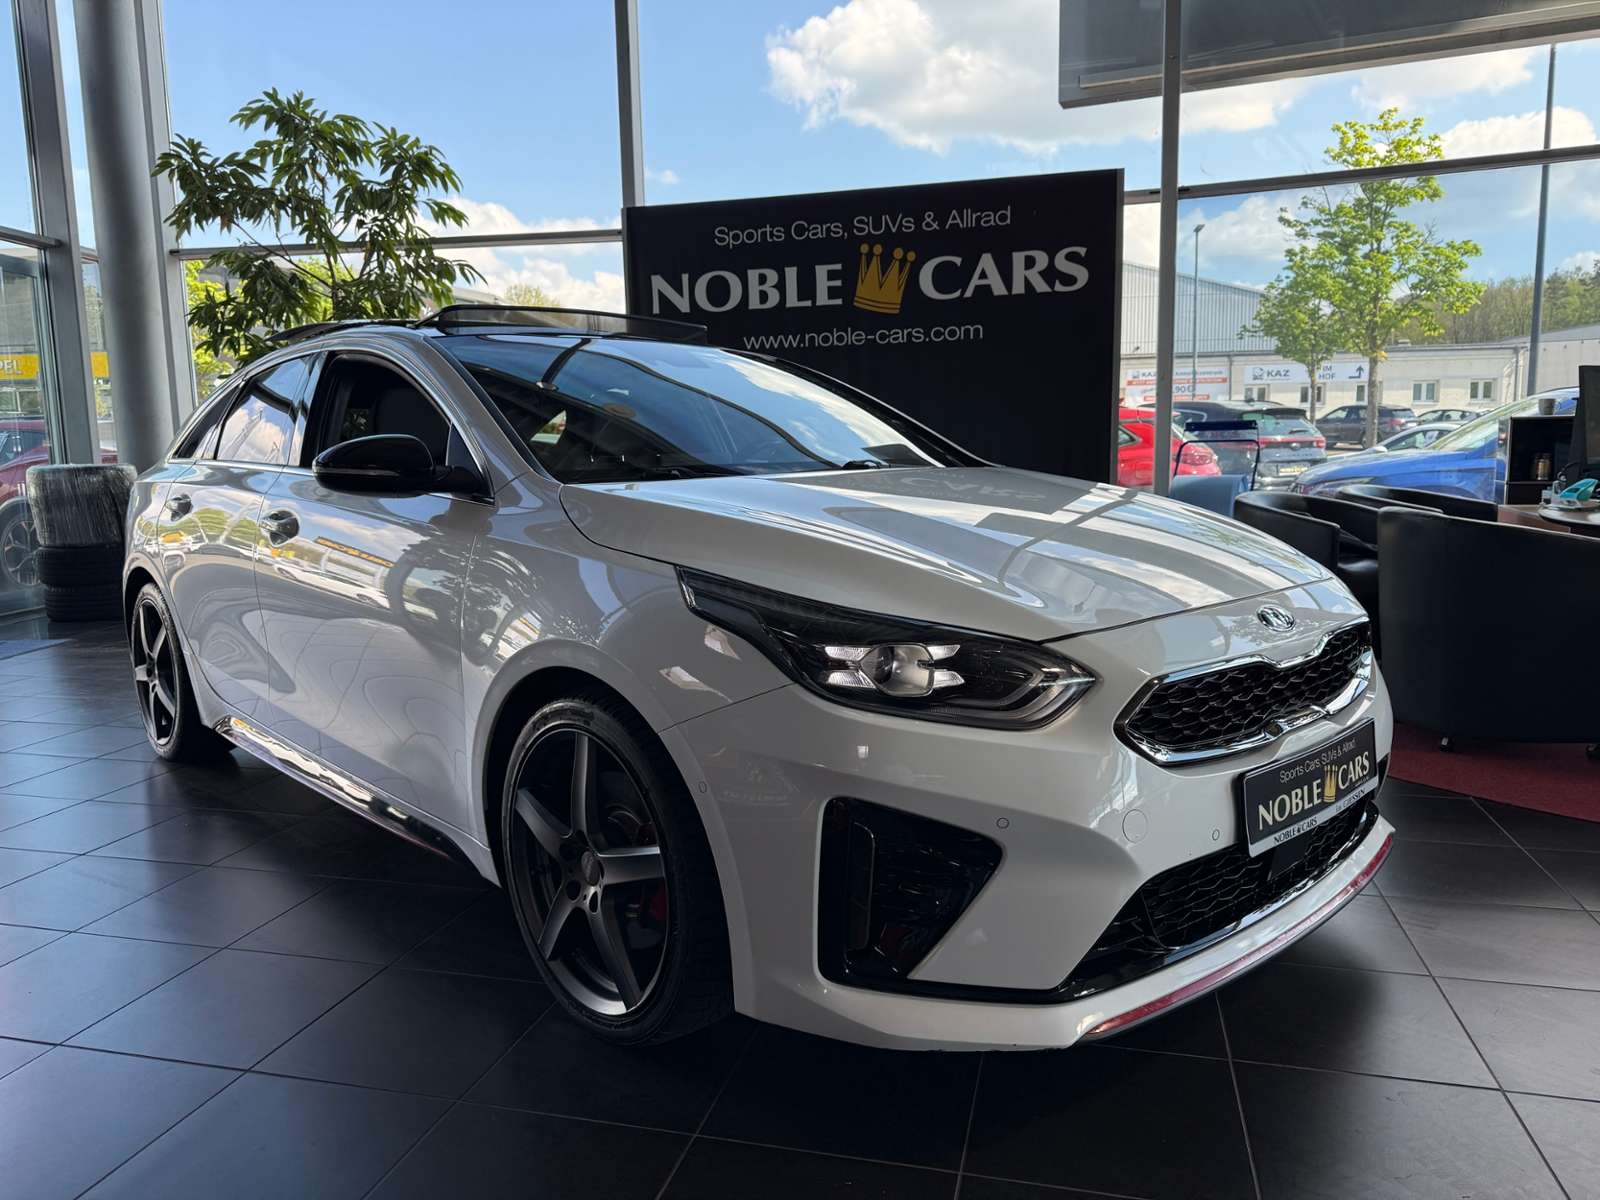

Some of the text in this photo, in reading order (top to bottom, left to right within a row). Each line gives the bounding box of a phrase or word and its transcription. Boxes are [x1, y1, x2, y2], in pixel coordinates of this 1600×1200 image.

[714, 206, 1011, 249] Sports Cars, SUVs & Allrad
[650, 246, 1089, 315] NOBLE CARS
[743, 322, 984, 351] www.noble-cars.com
[1266, 368, 1291, 378] KAZ
[1280, 766, 1304, 783] Sports
[1257, 751, 1370, 830] NOBLE CARS
[1273, 817, 1318, 845] NOBLE CARS
